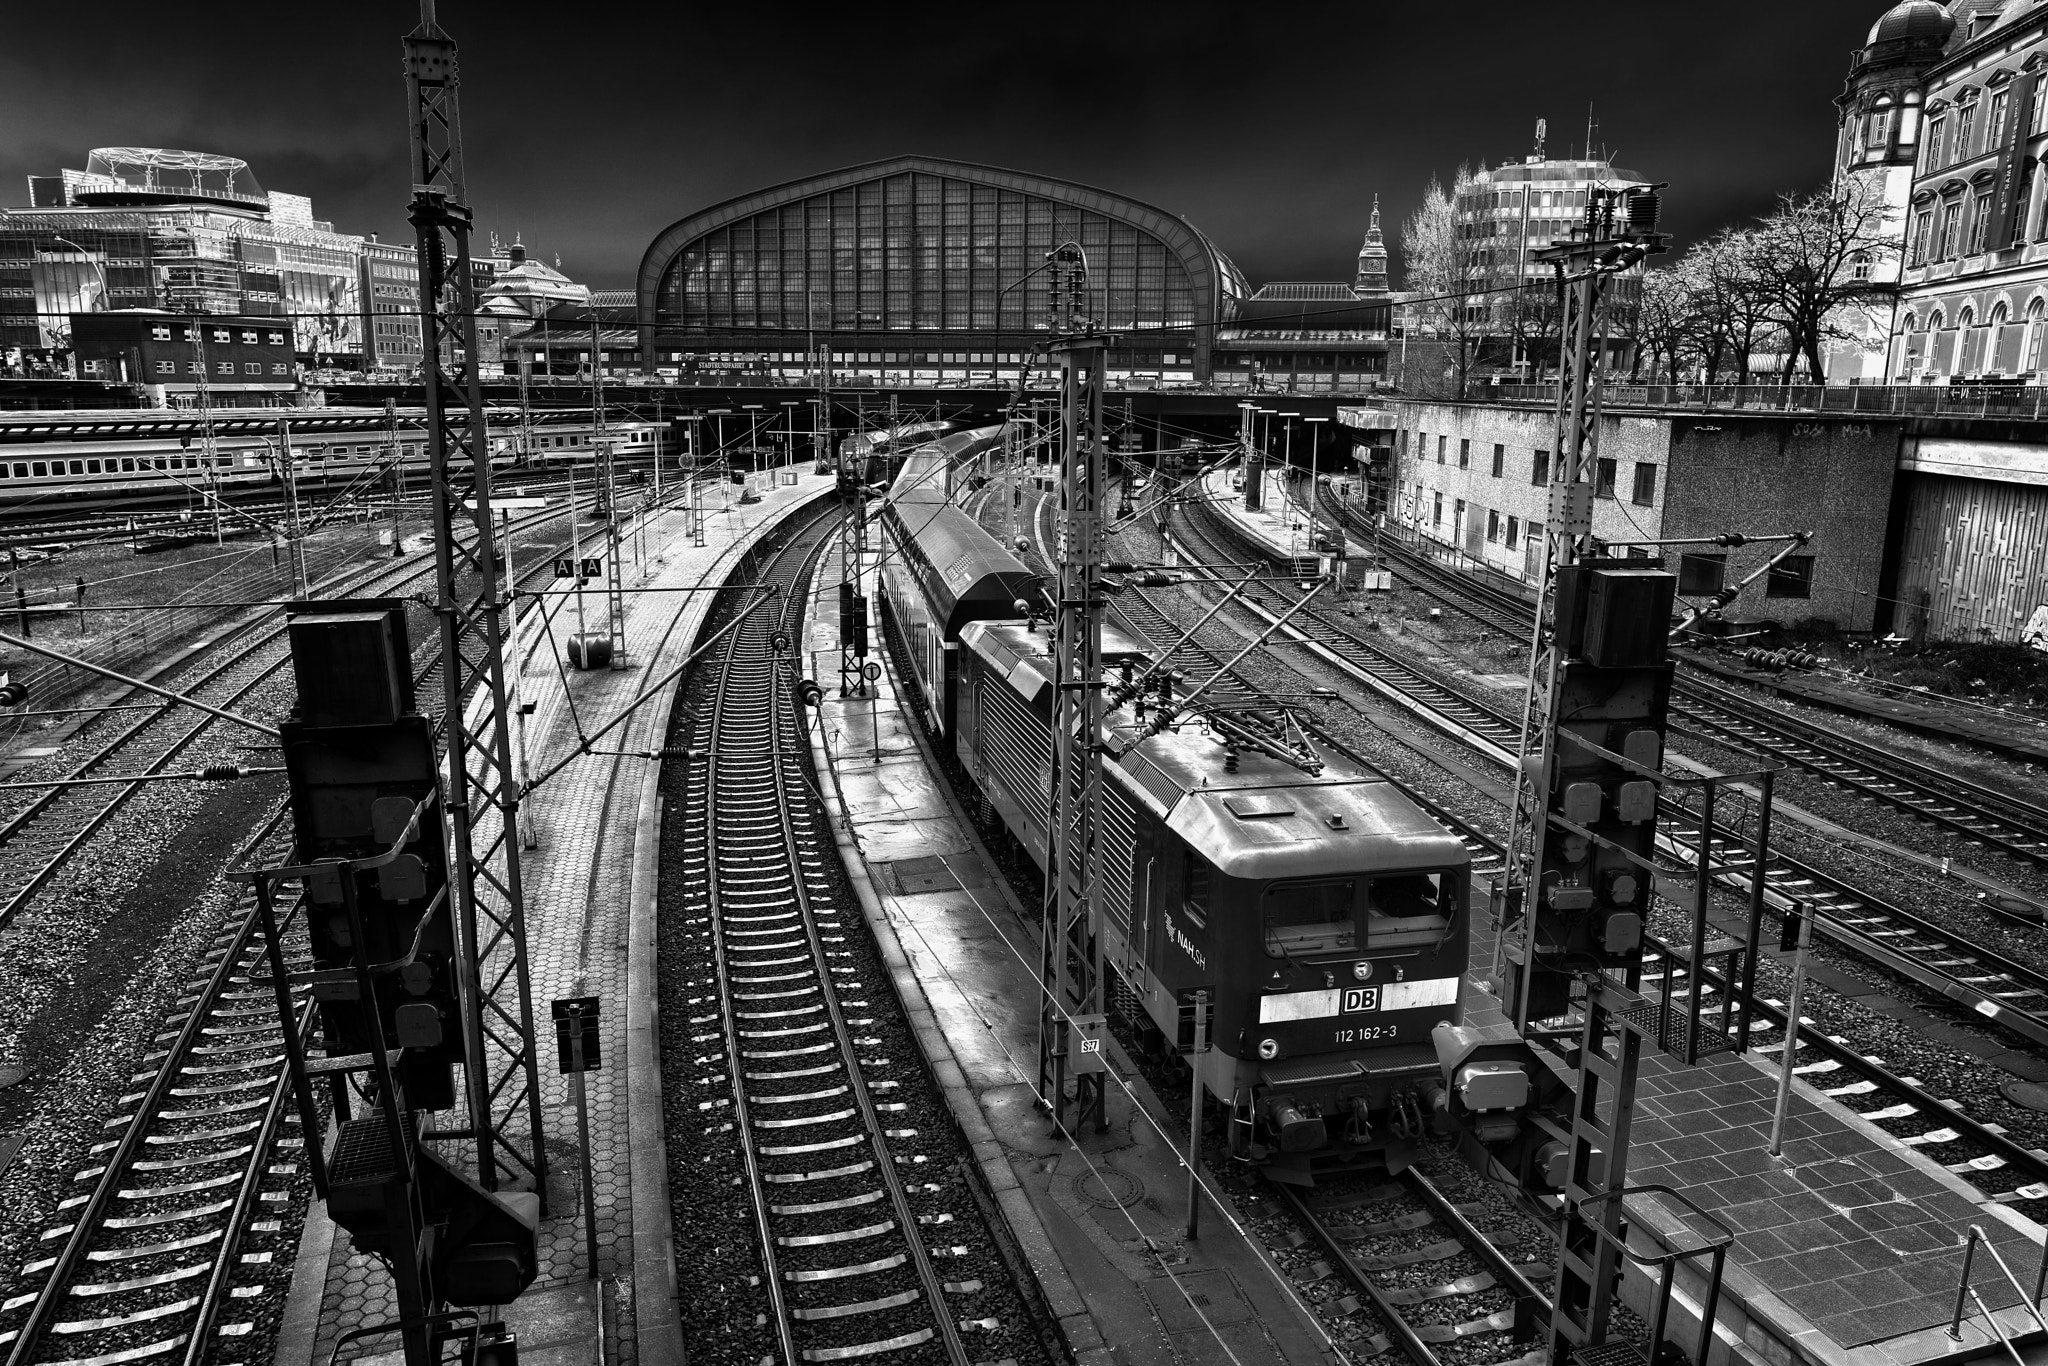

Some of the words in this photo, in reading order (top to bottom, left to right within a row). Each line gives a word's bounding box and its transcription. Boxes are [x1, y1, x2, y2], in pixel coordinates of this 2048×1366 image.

[698, 361, 745, 369] STADTRUNDFAHRT
[557, 560, 569, 574] A
[587, 559, 599, 573] A
[1177, 929, 1206, 971] NAH.SH
[1346, 990, 1375, 1010] DB
[1335, 1029, 1354, 1043] 112
[1358, 1025, 1397, 1041] 162-3
